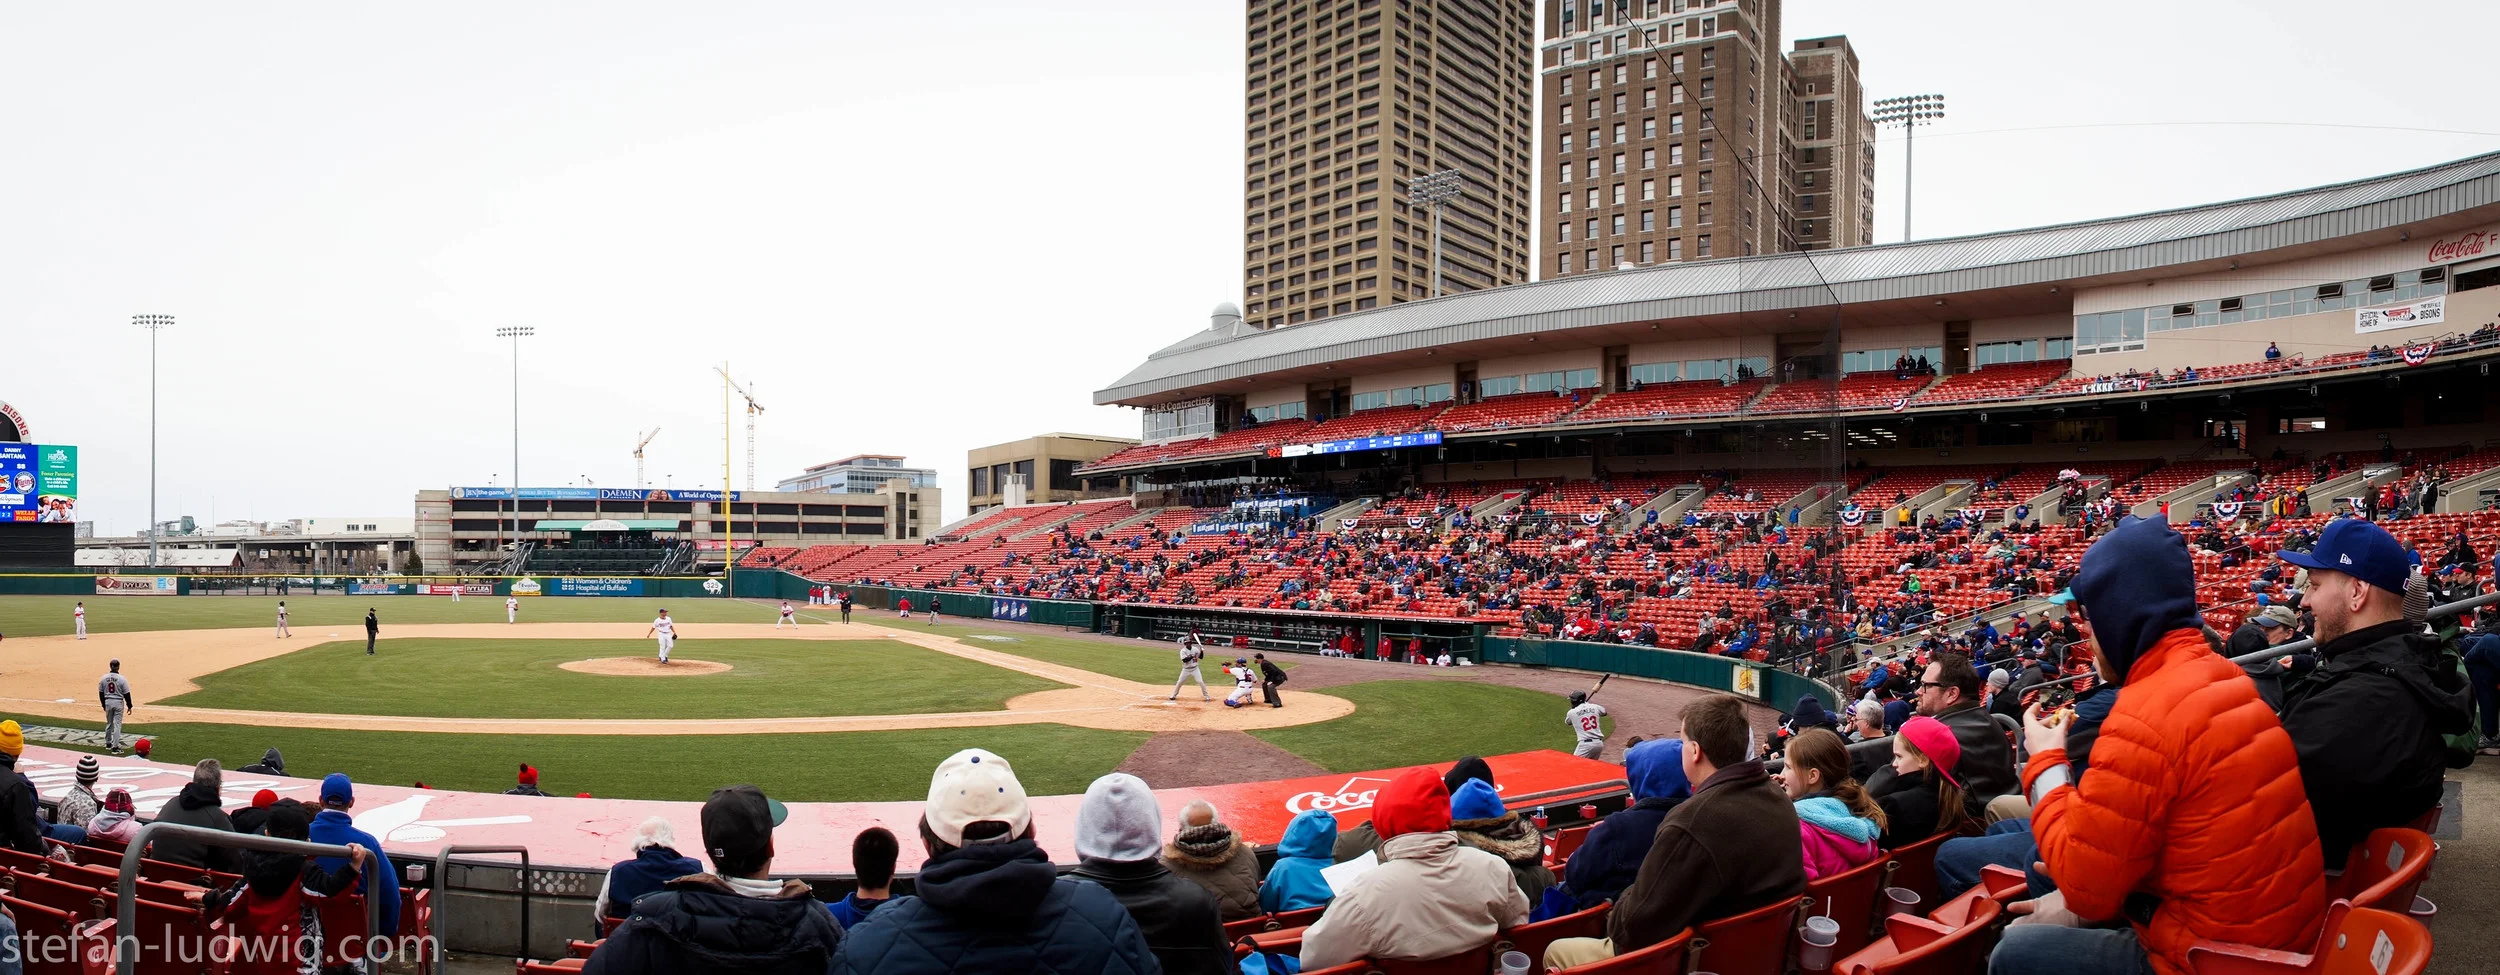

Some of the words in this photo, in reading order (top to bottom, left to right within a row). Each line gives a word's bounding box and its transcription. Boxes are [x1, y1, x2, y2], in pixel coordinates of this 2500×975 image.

[2360, 311, 2378, 321] OFFICIAL
[2420, 308, 2441, 319] BISONS
[2360, 319, 2372, 328] HOME
[2372, 318, 2378, 327] OF
[1166, 397, 1212, 410] Contracting
[2, 404, 29, 436] BISONS
[601, 489, 642, 498] DAEMEN
[575, 584, 599, 592] Hospital
[108, 682, 115, 693] 8
[1581, 715, 1598, 731] 23
